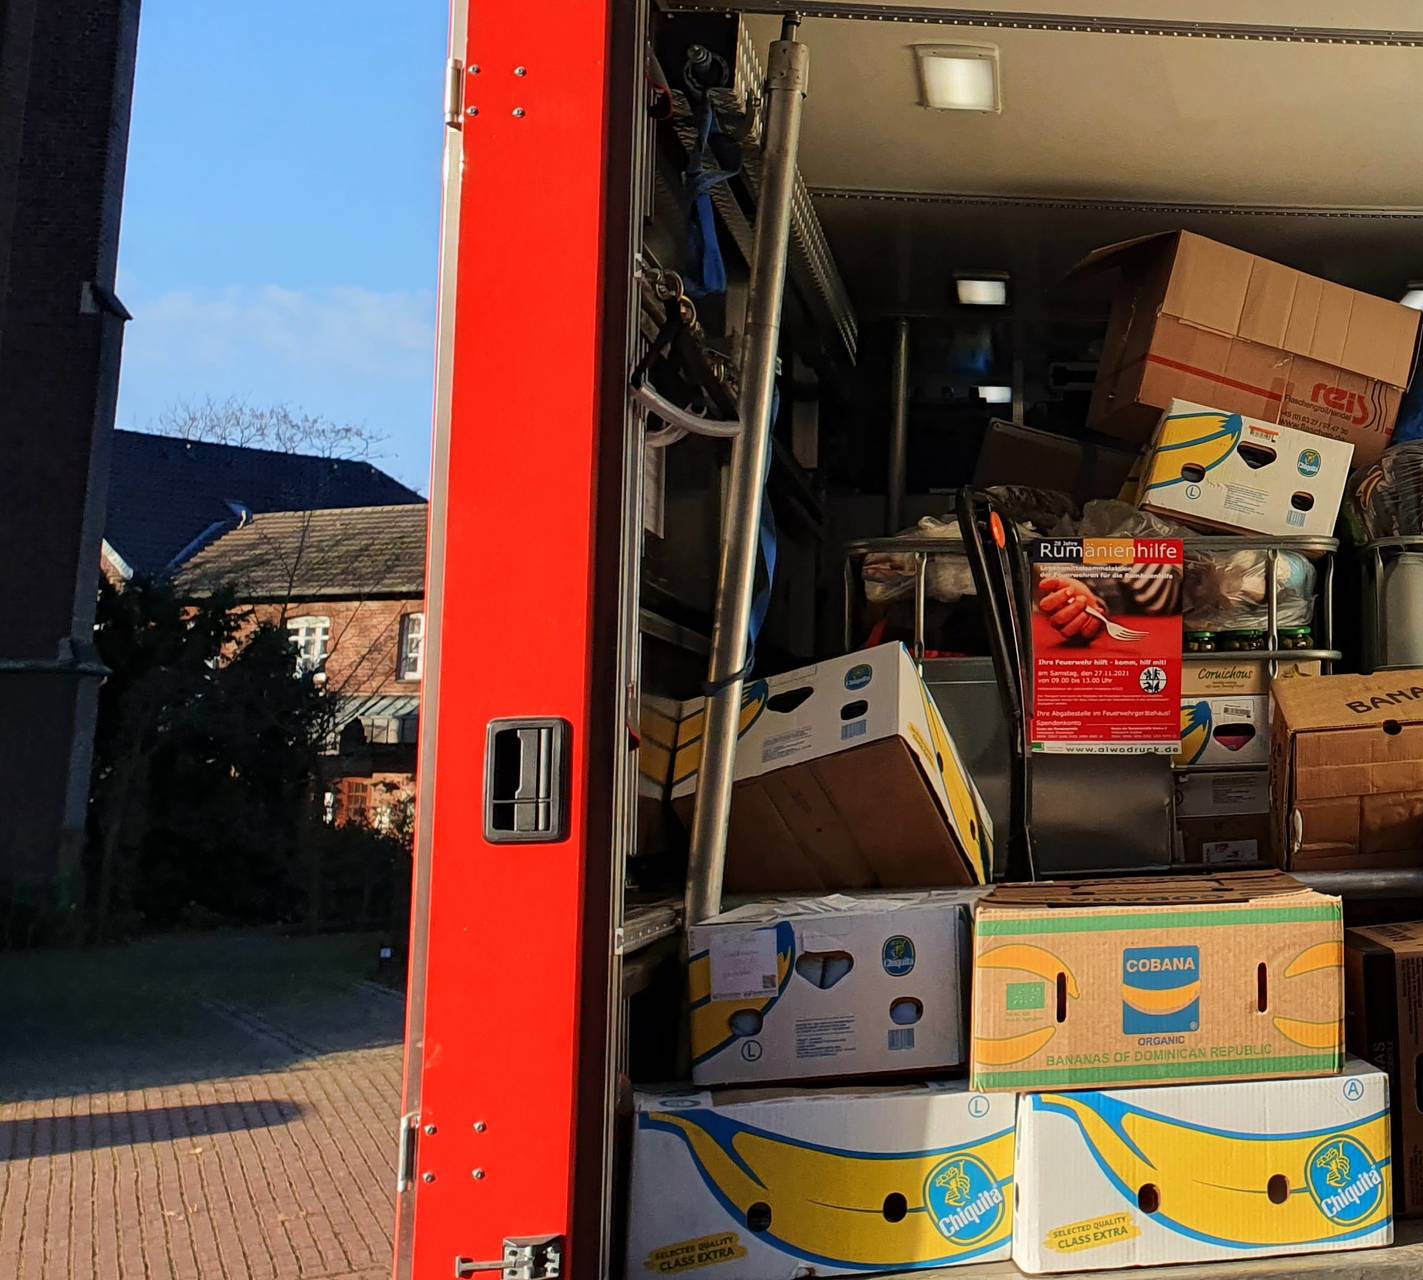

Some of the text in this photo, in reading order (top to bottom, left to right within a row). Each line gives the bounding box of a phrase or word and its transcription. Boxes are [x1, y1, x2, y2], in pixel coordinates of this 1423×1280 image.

[1311, 383, 1369, 425] reis
[1040, 542, 1177, 559] Rumänienhilfe
[1049, 670, 1079, 678] Samstag,
[1051, 710, 1091, 718] Abgabestelle
[1126, 956, 1195, 973] COBANA
[1137, 1035, 1186, 1047] ORGANIC
[1046, 1043, 1273, 1066] BANANAS OF DOMINICAN REPUBLIC
[1320, 1166, 1382, 1220] Chiquita
[939, 1183, 1004, 1239] Chiquita
[1052, 1216, 1127, 1240] SELECTED QUALITY
[1057, 1226, 1129, 1250] CLASS EXTRA
[697, 1236, 735, 1253] QUALITY
[660, 1247, 735, 1273] CLASS EXTRA
